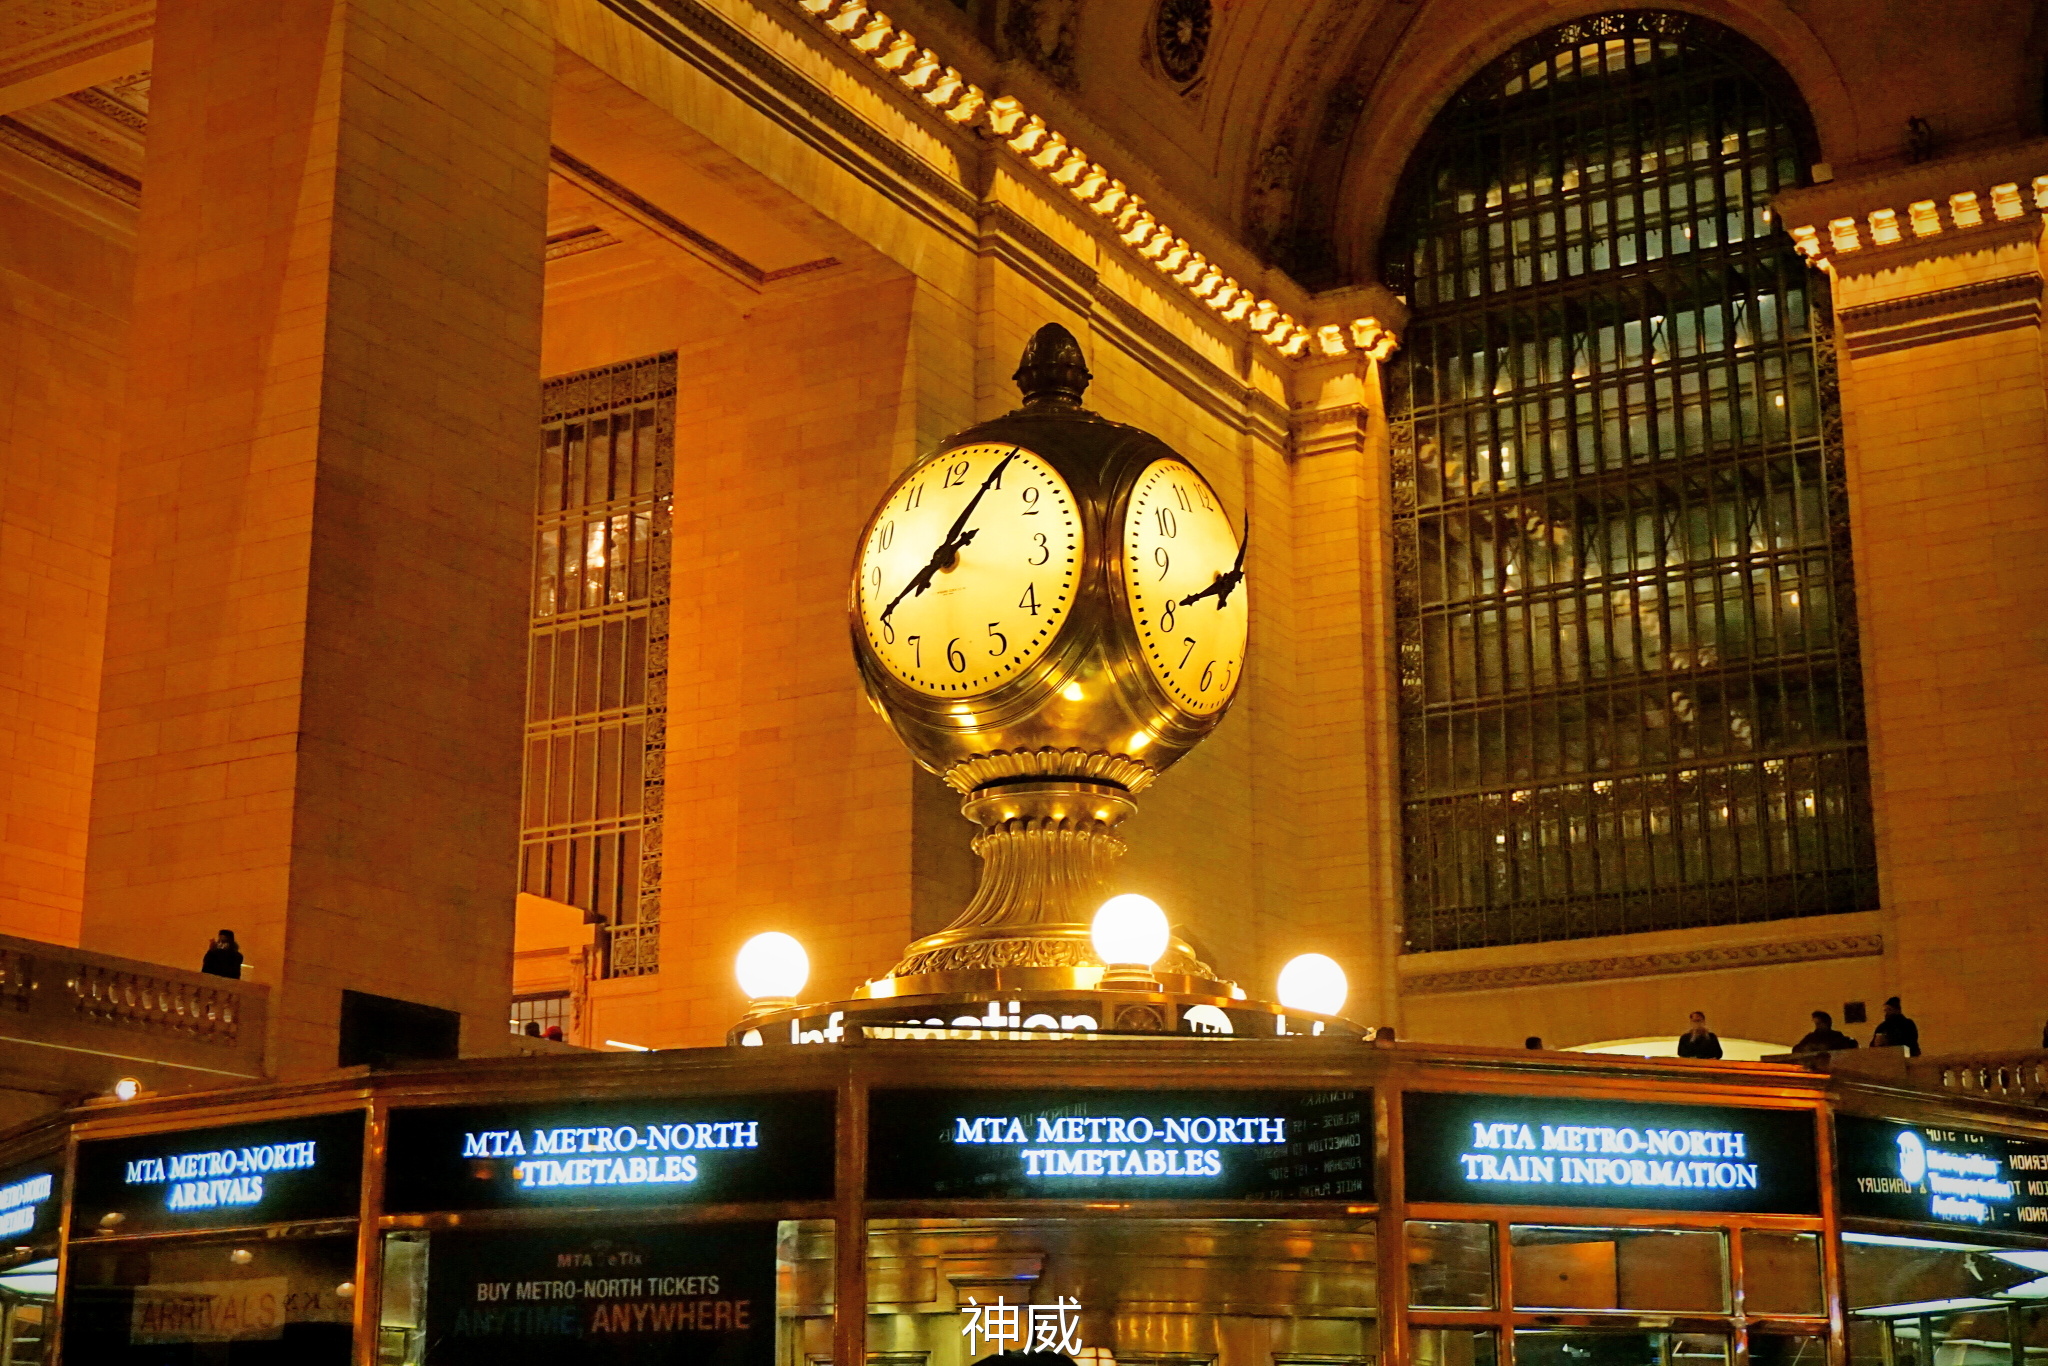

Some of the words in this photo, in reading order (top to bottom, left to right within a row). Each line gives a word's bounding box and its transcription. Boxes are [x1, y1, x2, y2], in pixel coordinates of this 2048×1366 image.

[943, 461, 969, 489] 12
[905, 482, 925, 512] 11
[1021, 487, 1040, 516] 2
[1172, 483, 1193, 513] 11
[1193, 482, 1213, 512] 12
[878, 520, 894, 553] 10
[1155, 506, 1176, 538] 10
[1028, 532, 1049, 566] 3
[1155, 547, 1169, 582] 9
[872, 566, 881, 600] 9
[1018, 582, 1042, 616] 4
[883, 612, 895, 645] 8
[1160, 599, 1176, 632] 8
[907, 635, 921, 668] 7
[947, 637, 966, 673] 6
[988, 621, 1007, 656] 5
[1178, 636, 1196, 669] 7
[1200, 660, 1216, 692] 6
[1220, 660, 1233, 691] 5
[463, 1130, 526, 1158] MTA
[532, 1121, 759, 1155] METRO-NORTH
[956, 1117, 1028, 1143] MTA
[1035, 1117, 1286, 1144] METRO-NORTH
[1473, 1122, 1536, 1150] MTA
[1541, 1125, 1745, 1158] METRO-NORTH
[126, 1157, 165, 1184] MTA
[169, 1141, 316, 1180] METRO-NORTH
[520, 1155, 698, 1187] TIMETABLES
[1021, 1149, 1222, 1176] TIMETABLES
[1461, 1154, 1554, 1183] TRAIN
[1560, 1156, 1758, 1188] INFORMATION
[169, 1176, 263, 1209] ARRIVALS
[557, 1253, 593, 1268] MTA
[477, 1282, 511, 1301] BUY
[516, 1278, 642, 1301] METRO-NORTH
[648, 1275, 720, 1297] TICKETS
[591, 1299, 752, 1334] ANYWHERE
